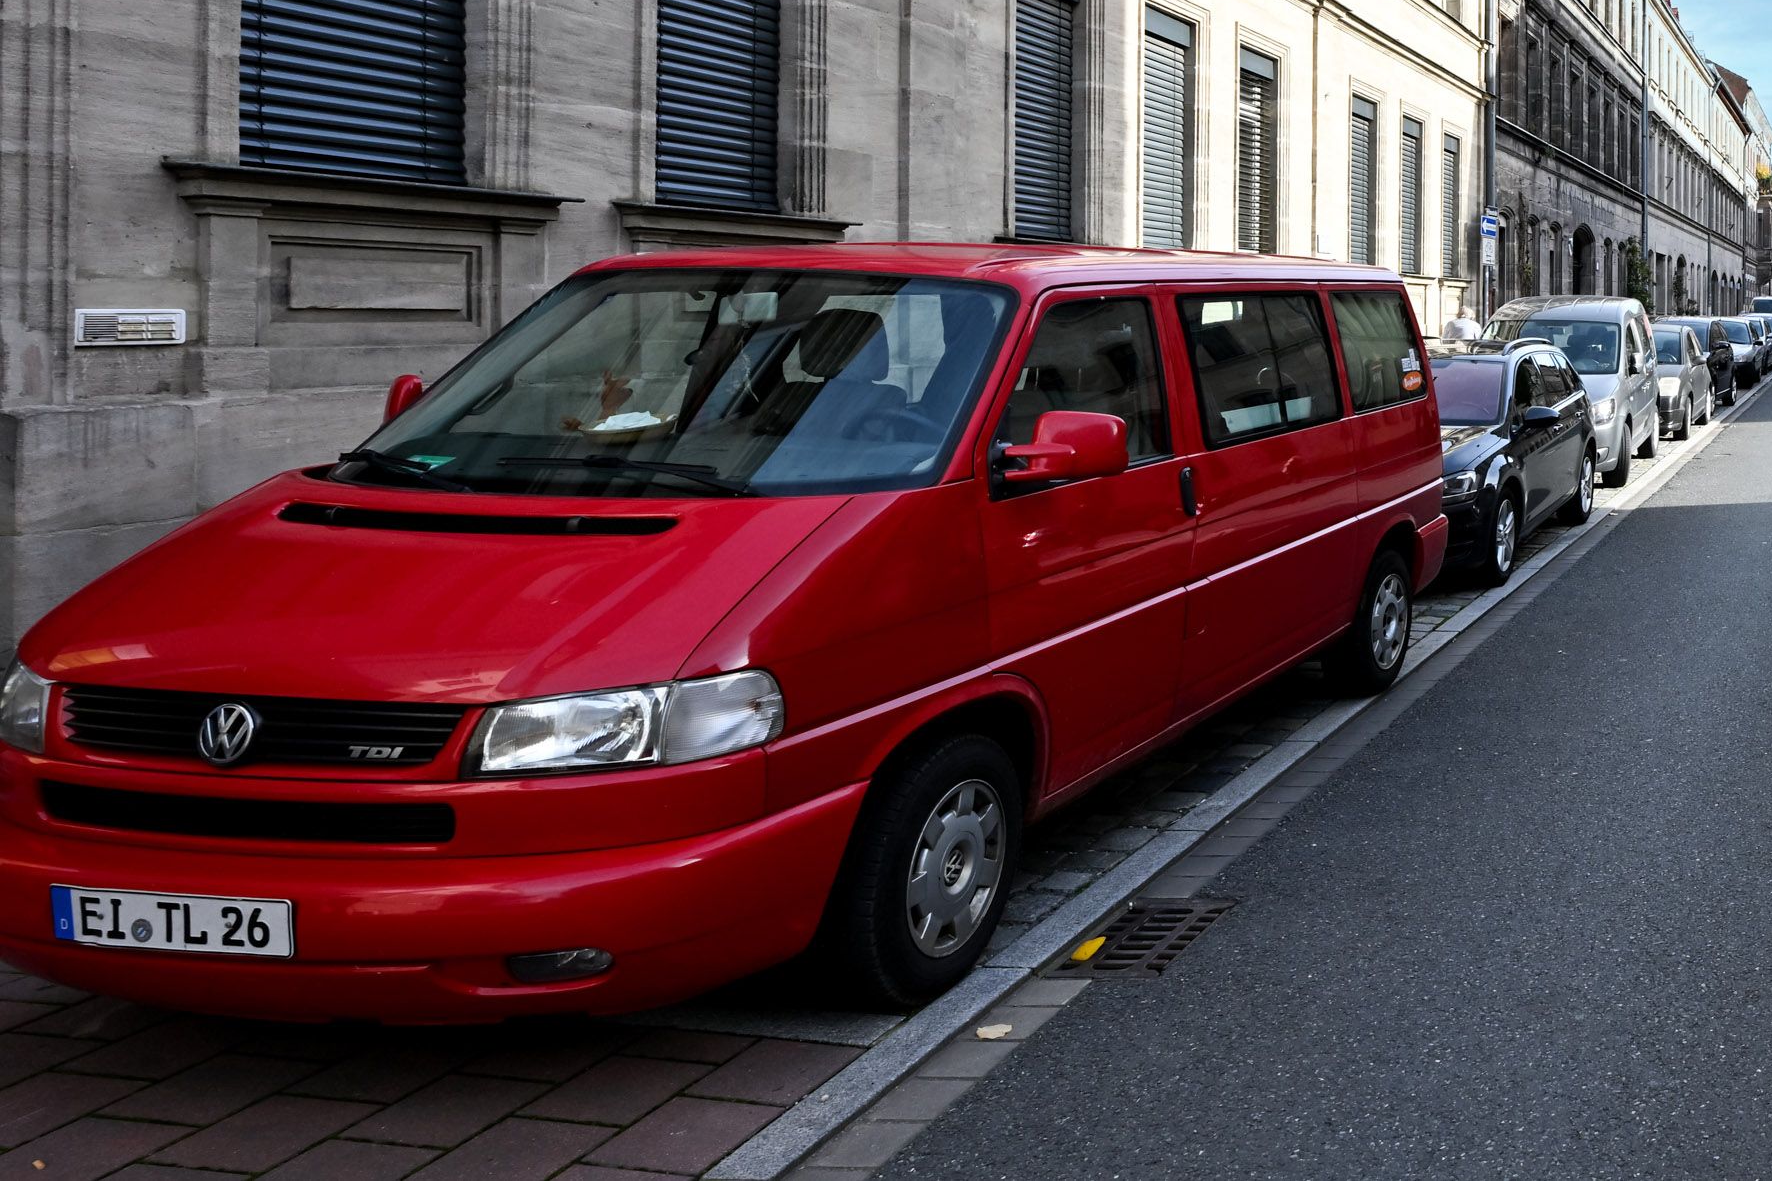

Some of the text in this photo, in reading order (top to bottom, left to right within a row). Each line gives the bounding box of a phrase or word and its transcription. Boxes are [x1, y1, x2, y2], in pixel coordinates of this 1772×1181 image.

[200, 704, 255, 764] VW
[348, 745, 404, 760] TDI
[60, 918, 69, 930] D
[79, 896, 270, 948] EI TL 26
